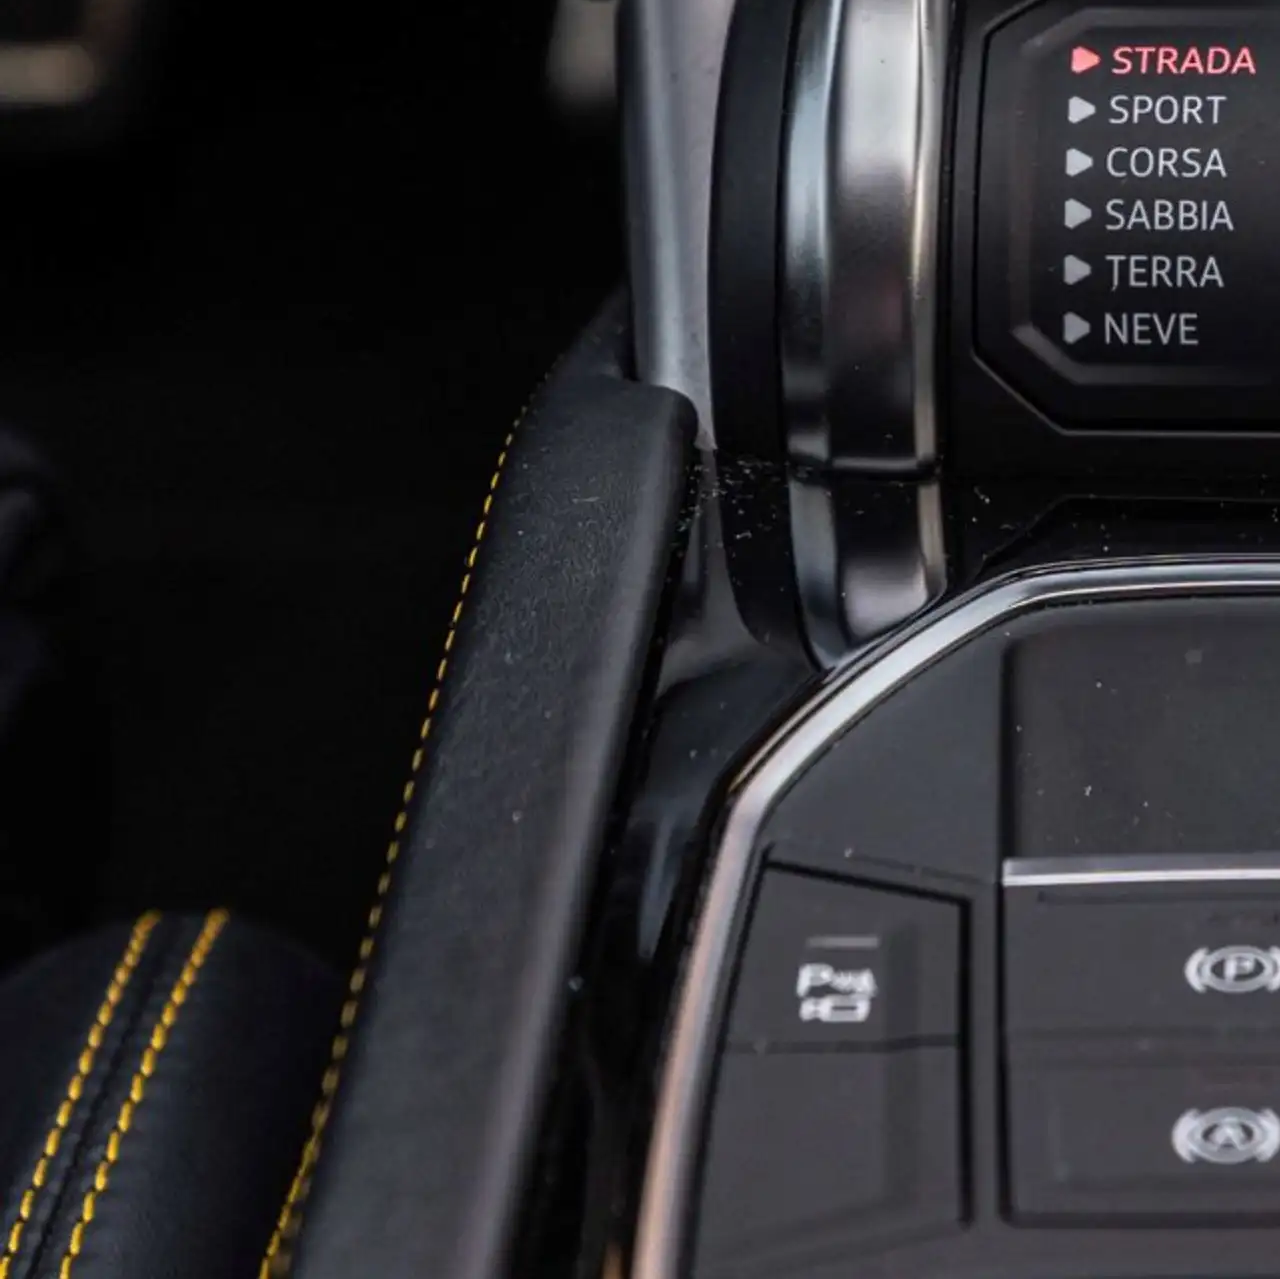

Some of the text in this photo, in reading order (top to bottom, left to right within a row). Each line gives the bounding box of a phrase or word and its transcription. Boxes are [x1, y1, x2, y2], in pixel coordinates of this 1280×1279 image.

[1112, 46, 1256, 75] STRADA
[1109, 94, 1227, 124] SPORT
[1106, 146, 1227, 178] CORSA
[1105, 198, 1234, 231] SABBIA
[1105, 254, 1224, 288] TERRA
[1104, 312, 1199, 345] NEVE
